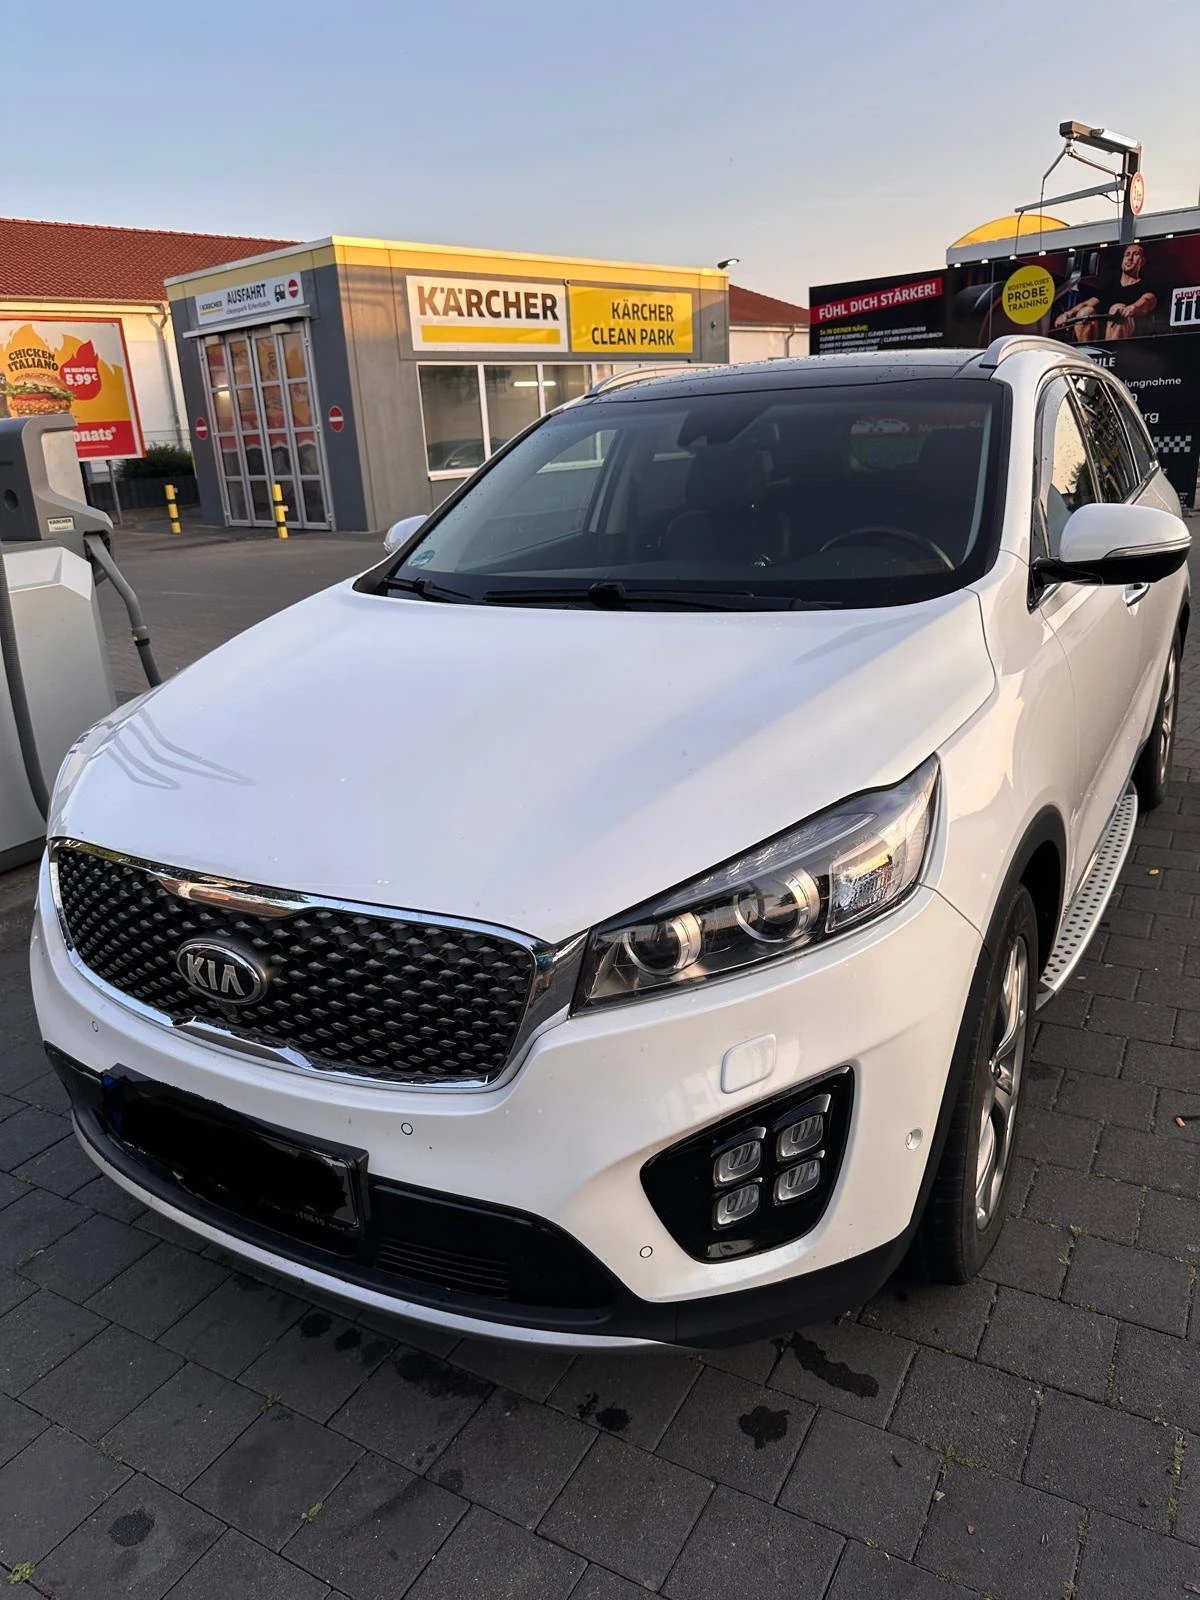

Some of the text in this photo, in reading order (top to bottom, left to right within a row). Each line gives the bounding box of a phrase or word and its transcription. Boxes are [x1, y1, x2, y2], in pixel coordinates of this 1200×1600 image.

[1008, 276, 1050, 291] KOSTENLOSES
[227, 283, 266, 305] AUSFAHRT
[819, 282, 936, 319] FÜHL DICH STÄRKER!
[1007, 285, 1049, 302] PROBE-
[1175, 289, 1200, 300] cleve
[417, 285, 559, 321] KÄRCHER
[611, 299, 675, 322] KÄRCHER
[1008, 296, 1049, 312] TRAINING
[591, 327, 675, 346] CLEAN PARK
[8, 348, 56, 362] CHICKEN
[8, 357, 59, 372] ITALIANO
[1124, 377, 1182, 389] lungnahme
[187, 953, 245, 996] KIA
